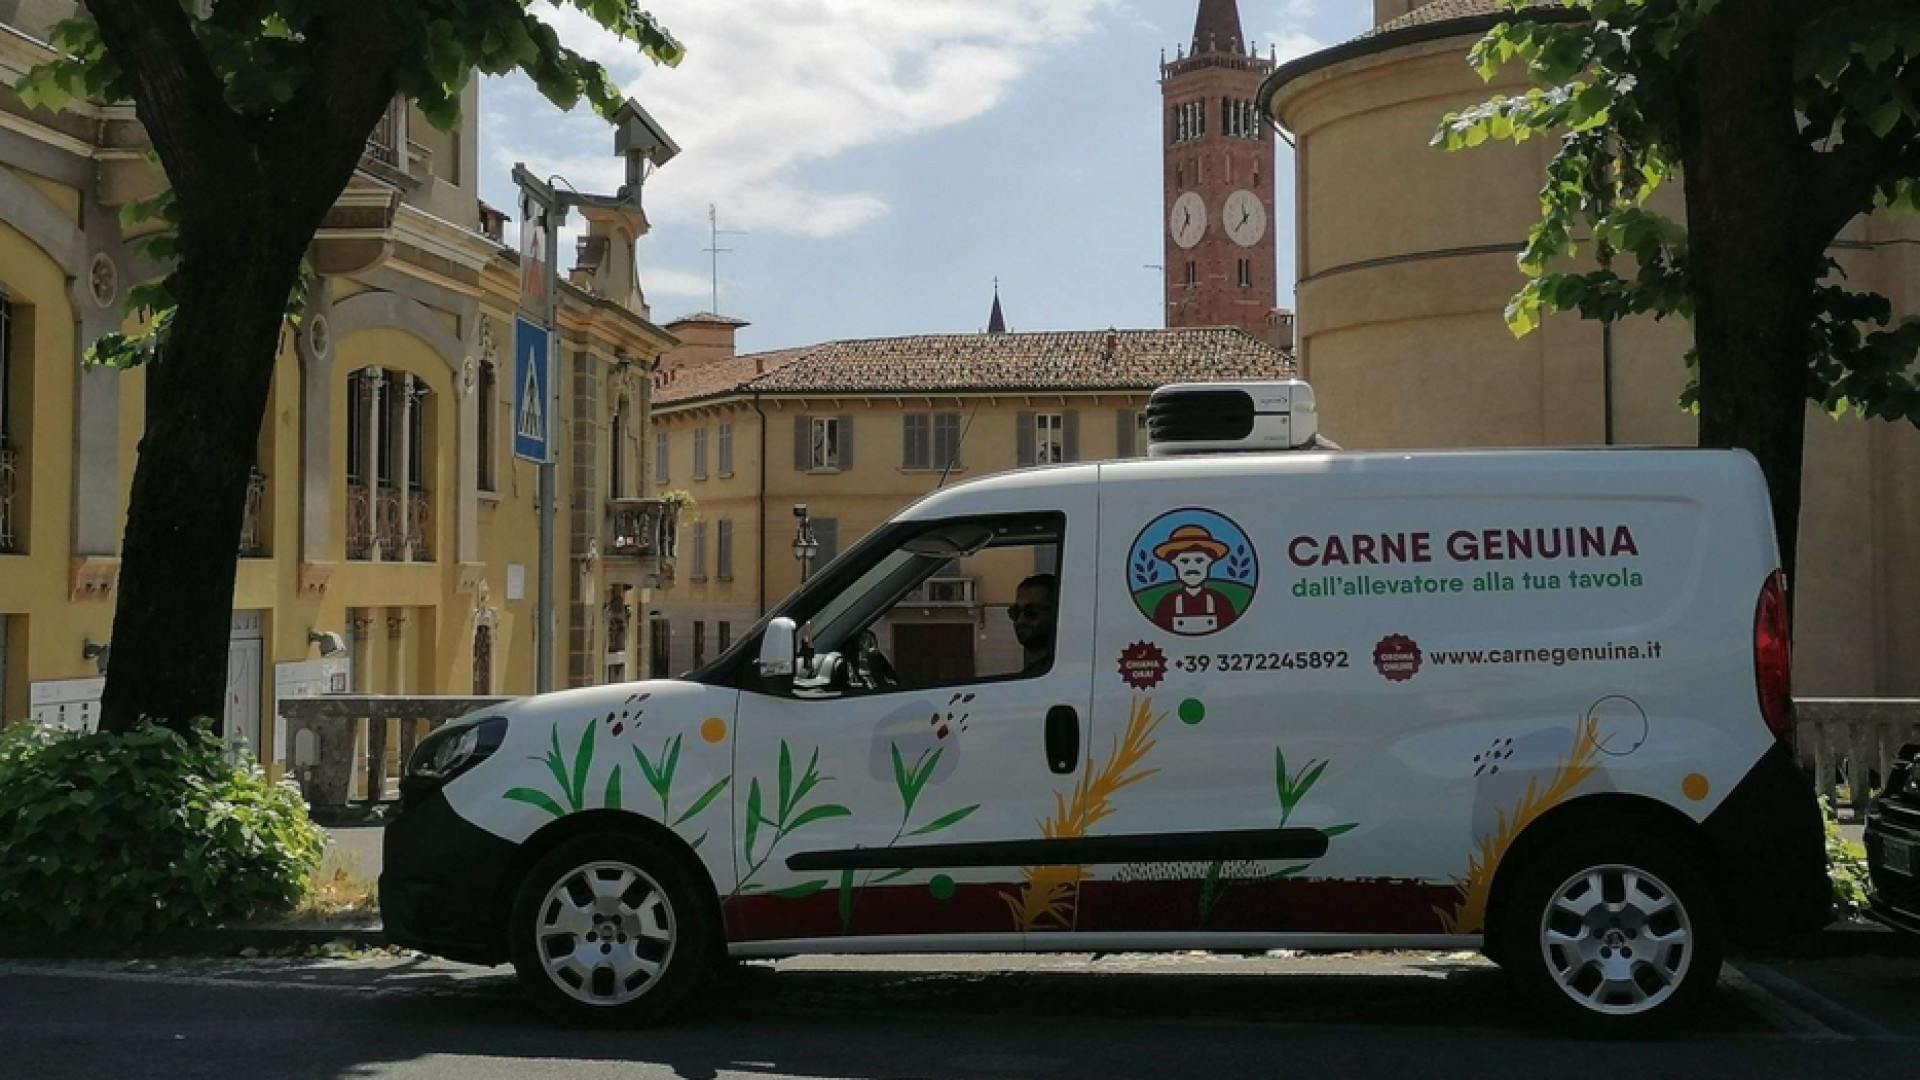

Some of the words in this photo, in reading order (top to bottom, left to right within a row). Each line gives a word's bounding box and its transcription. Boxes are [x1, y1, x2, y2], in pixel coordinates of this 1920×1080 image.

[1288, 532, 1432, 567] CARNE
[1446, 525, 1639, 562] GENUINA
[1471, 571, 1514, 593] alla
[1521, 571, 1561, 591] tua
[1567, 566, 1644, 590] tavola
[1175, 654, 1212, 674] +39
[1216, 649, 1350, 673] 3272245892
[1429, 641, 1662, 667] www.carnegenuina.it
